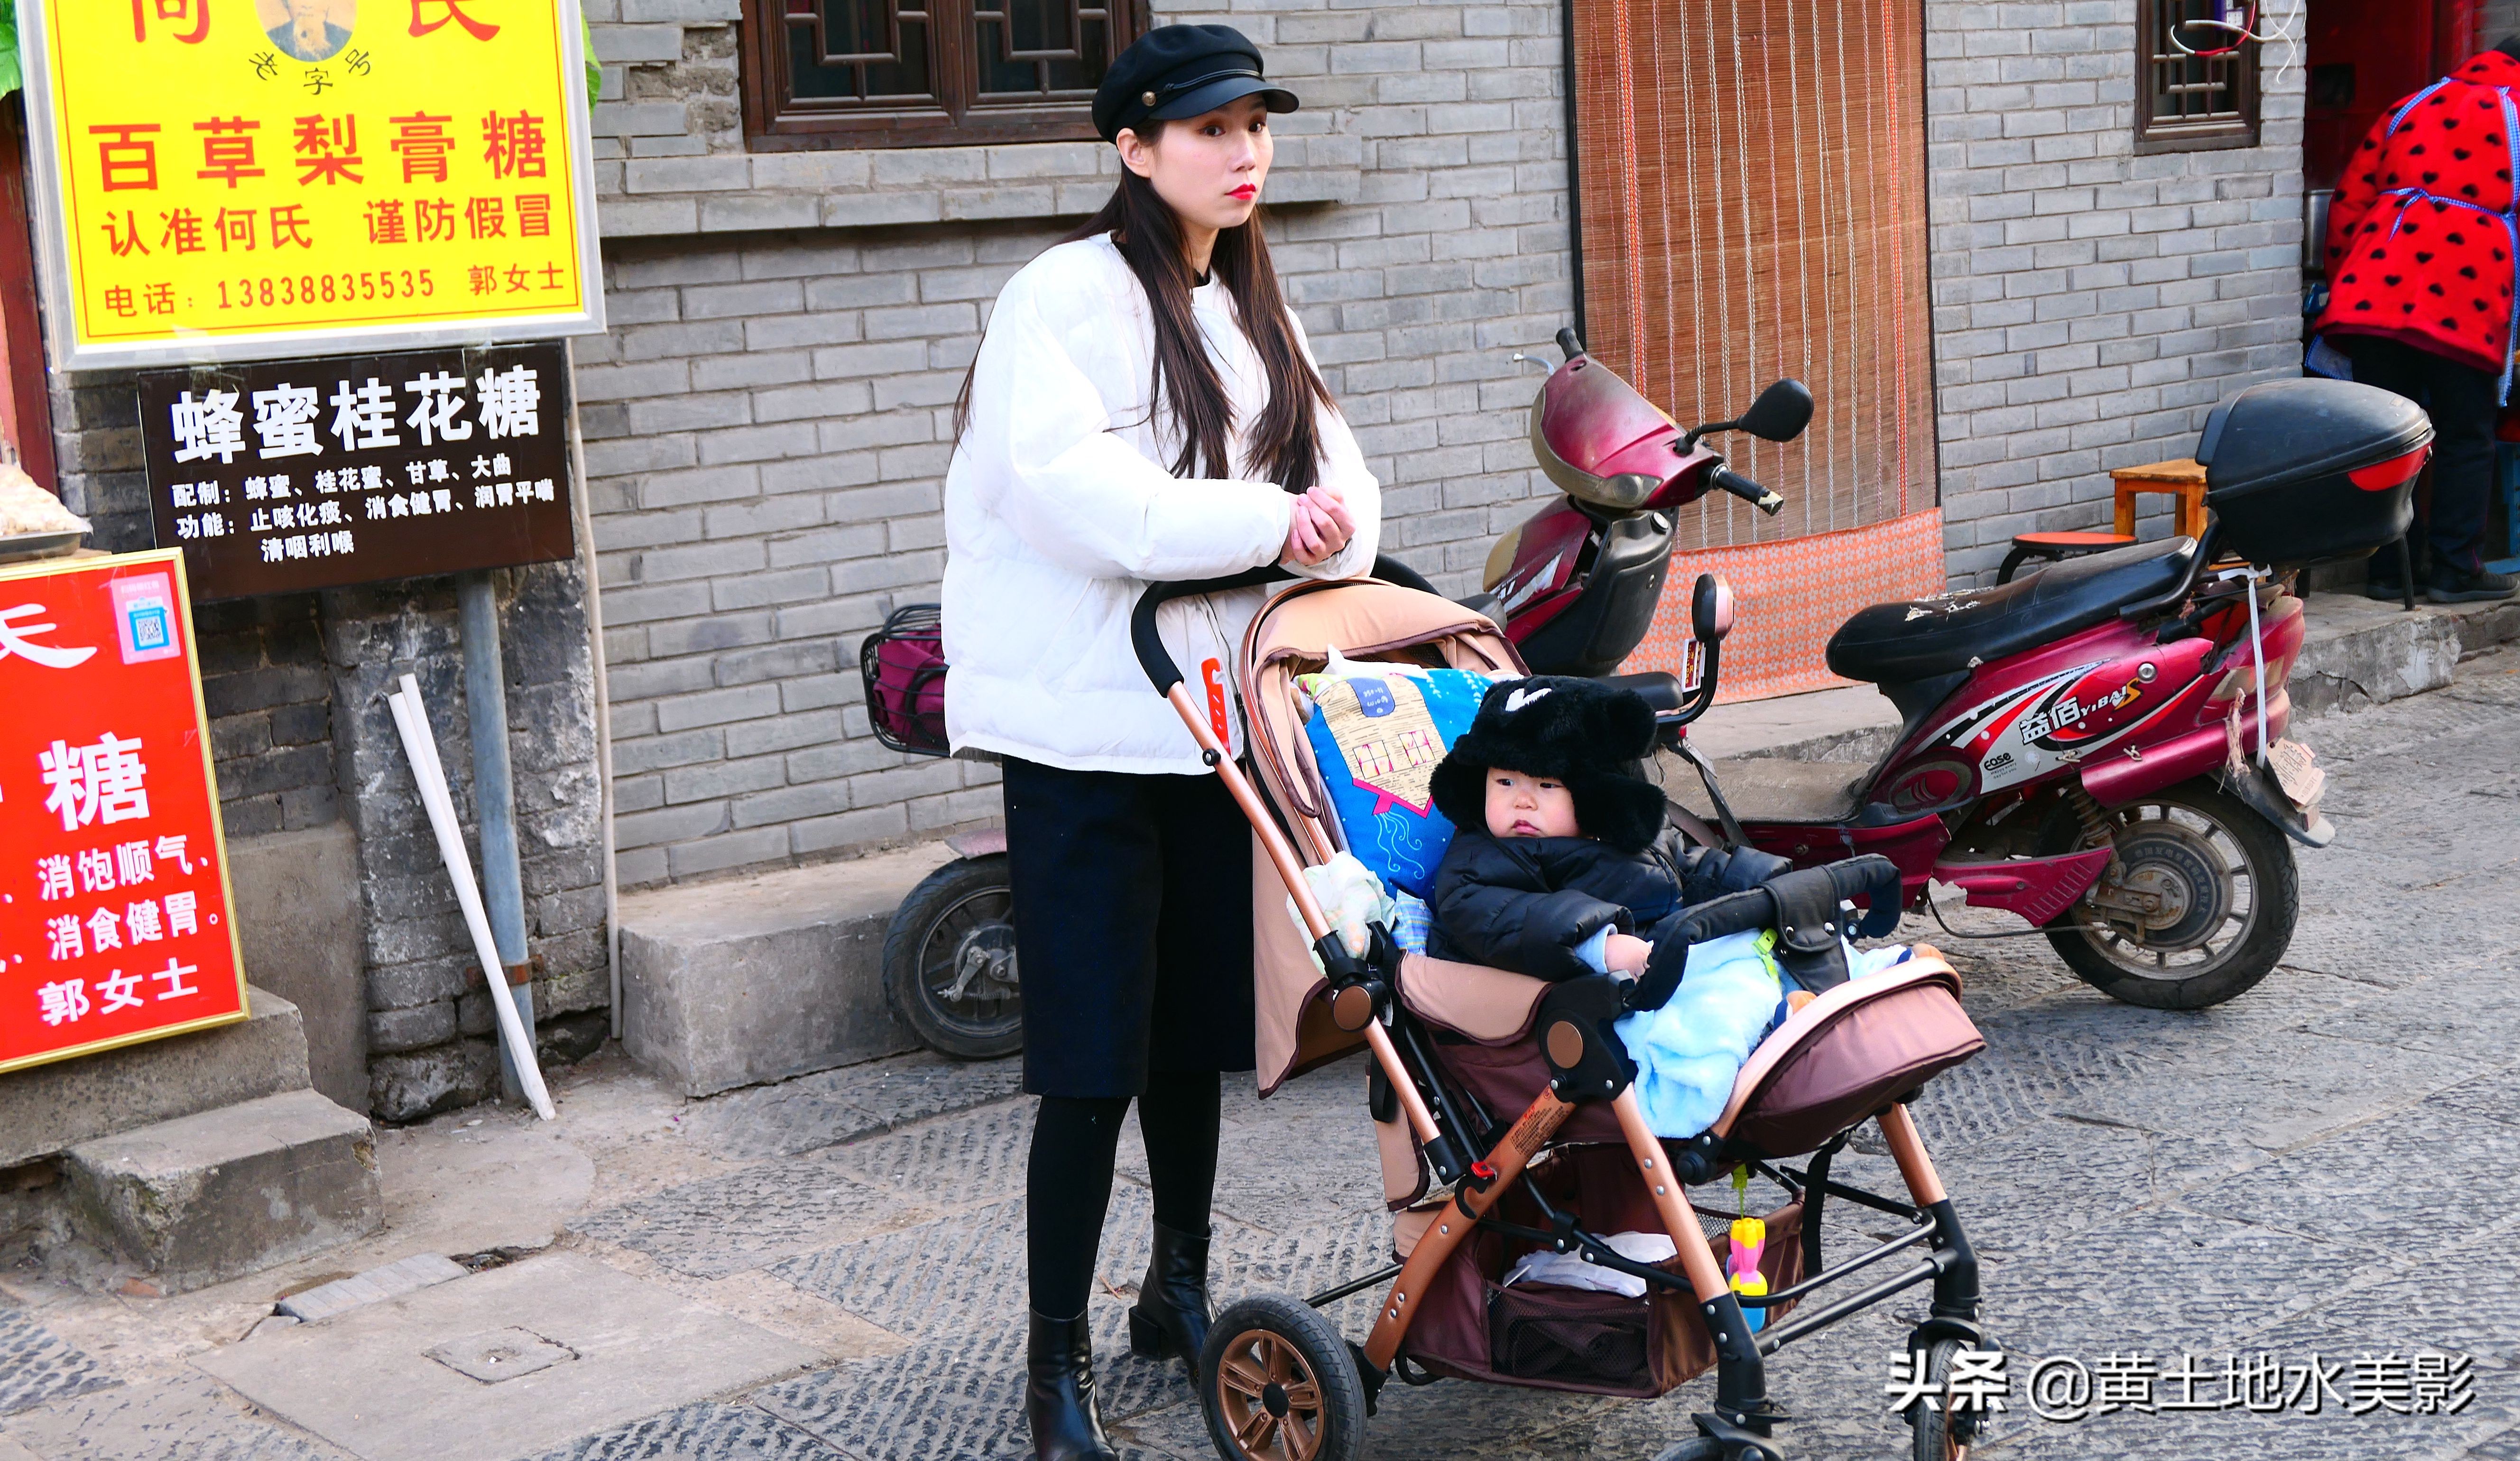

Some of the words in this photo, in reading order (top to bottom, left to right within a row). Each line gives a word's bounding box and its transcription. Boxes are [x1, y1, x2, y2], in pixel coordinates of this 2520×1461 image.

[249, 48, 371, 95] 老字号
[88, 109, 548, 192] 百草梨膏糖
[101, 203, 313, 257] 认准何氏
[363, 194, 551, 244] 谨防假冒
[468, 261, 564, 296] 郭女士
[171, 364, 541, 464] 蜂蜜桂花糖
[261, 530, 354, 563] 清咽利喉
[2020, 696, 2081, 745] 益佰
[39, 731, 150, 832] 糖
[38, 957, 199, 1027] 郭女士
